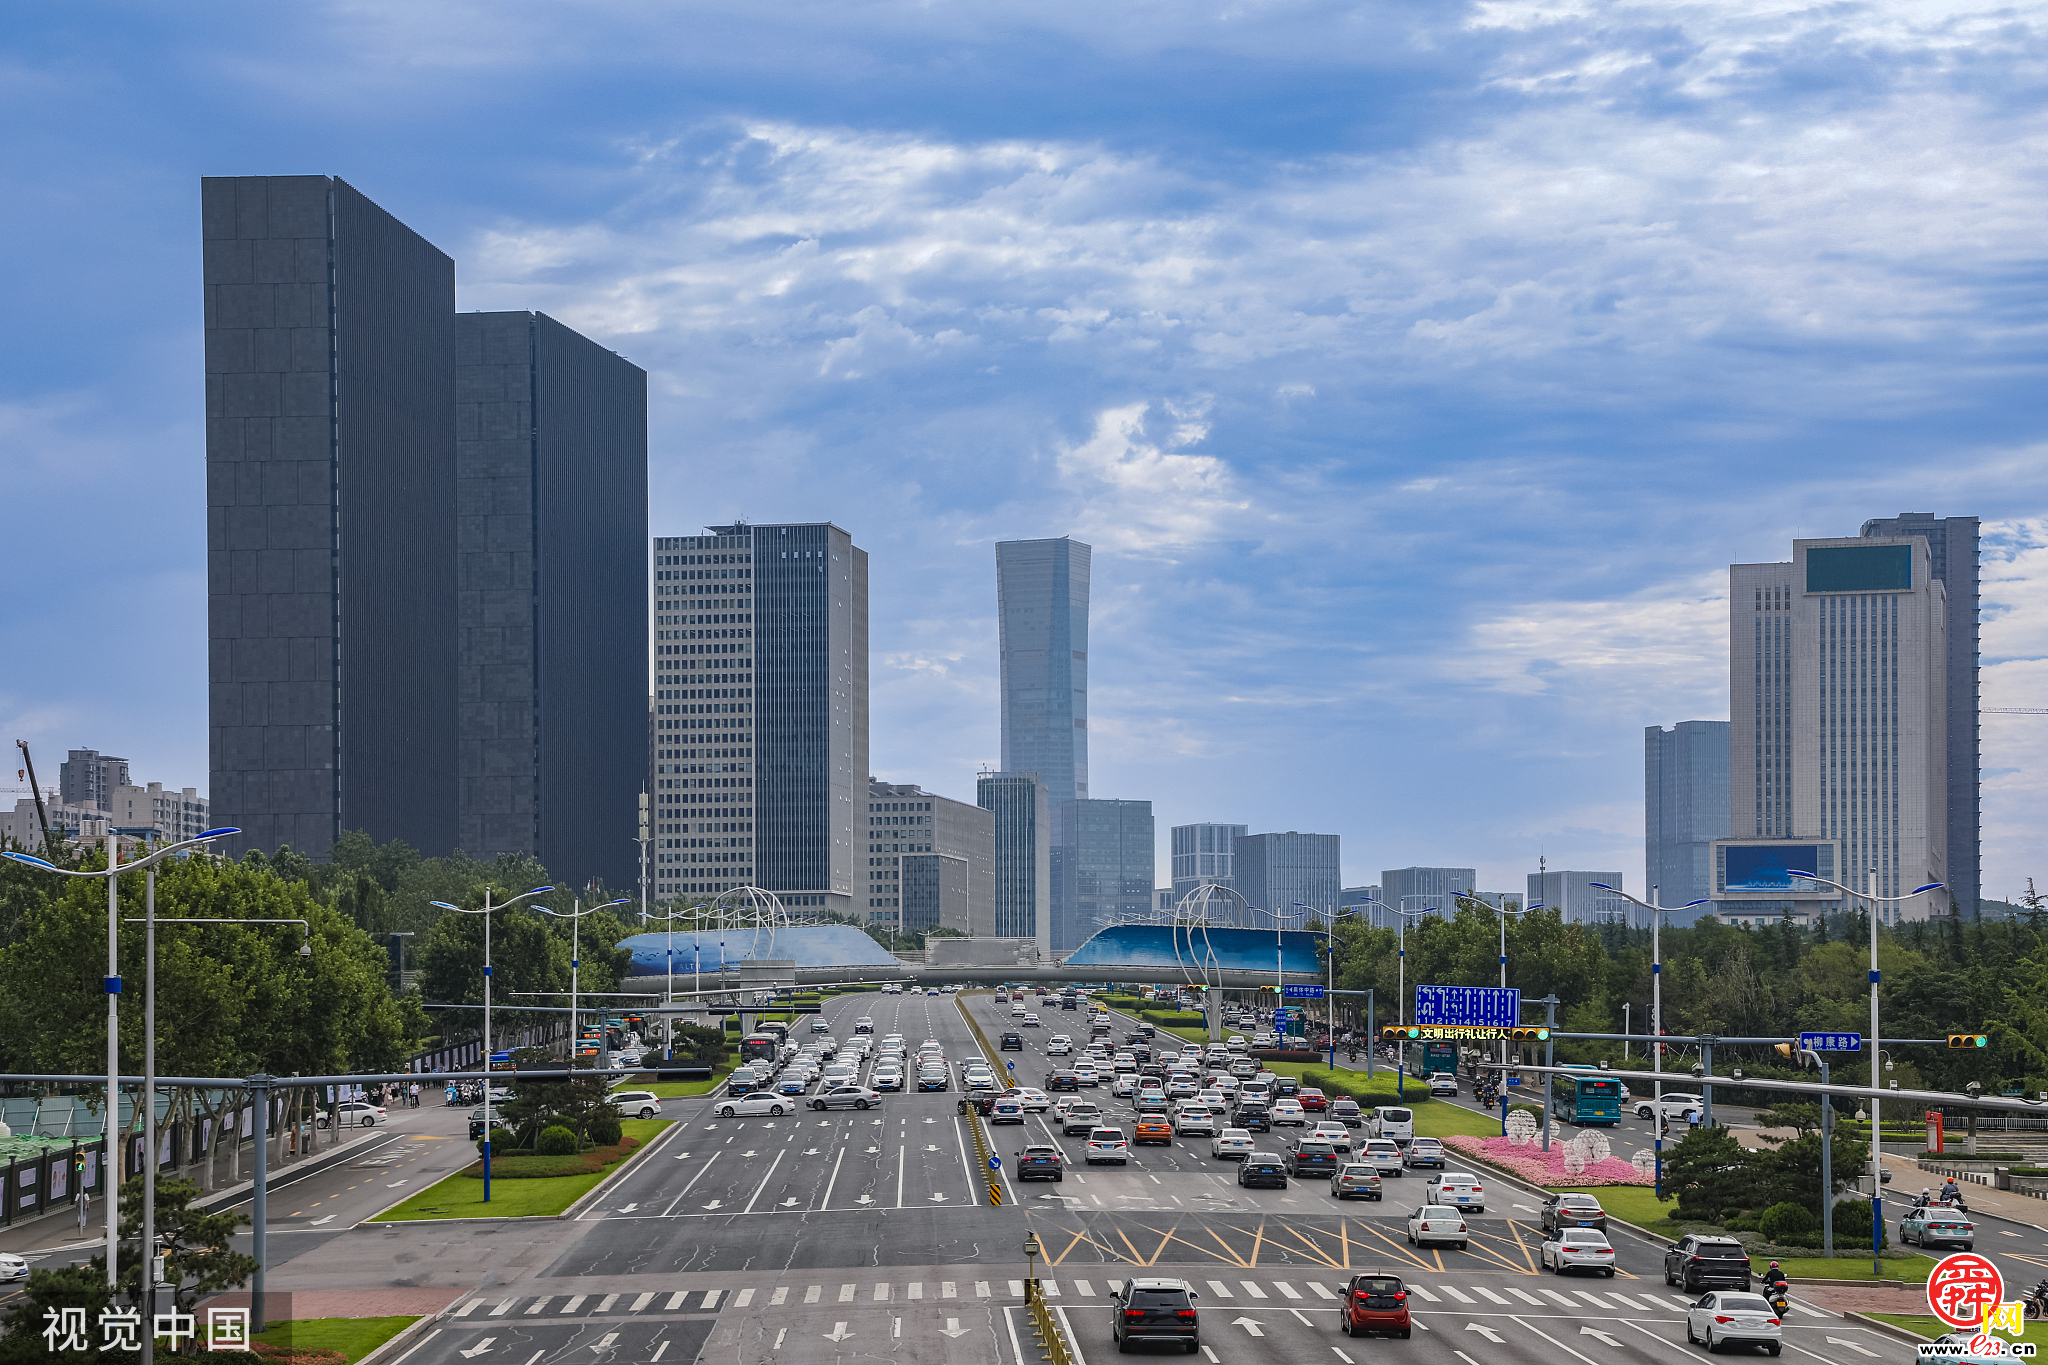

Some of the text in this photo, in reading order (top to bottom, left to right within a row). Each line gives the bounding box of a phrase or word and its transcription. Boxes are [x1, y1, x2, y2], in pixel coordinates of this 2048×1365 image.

[1478, 1018, 1484, 1026] 5
[1422, 1028, 1508, 1040] 文明出行礼让行人
[1813, 1036, 1848, 1047] 柳康路
